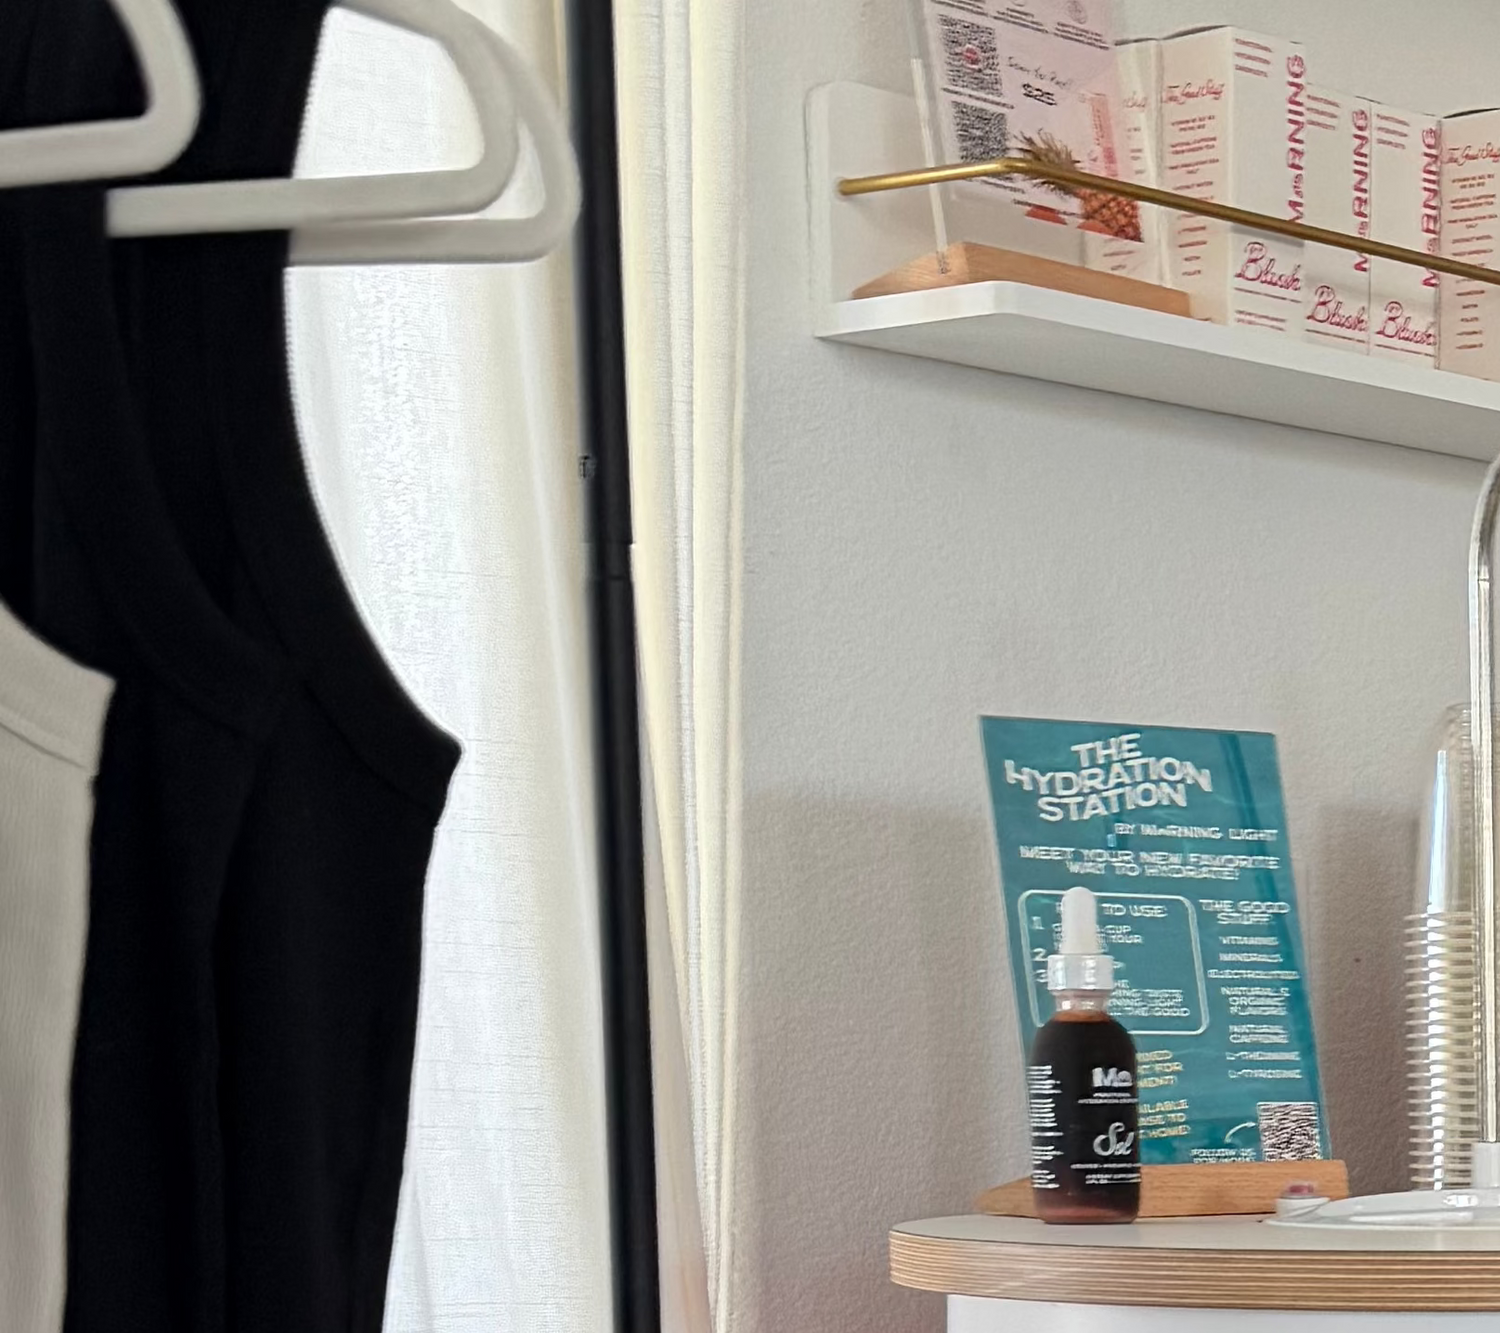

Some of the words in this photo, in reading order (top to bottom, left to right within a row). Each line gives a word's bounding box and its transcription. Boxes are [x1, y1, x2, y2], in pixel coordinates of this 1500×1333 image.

[1022, 82, 1057, 106] $25
[1234, 241, 1301, 291] Blush
[1306, 285, 1368, 332] Blush
[1375, 300, 1438, 346] Blush
[1070, 732, 1142, 768] THE
[1004, 756, 1213, 795] HYDRATION
[1036, 782, 1188, 822] STATION
[1114, 823, 1134, 835] BY
[1228, 828, 1279, 841] LIGHT
[1020, 845, 1075, 860] MEET
[1083, 848, 1135, 863] YOUR
[1139, 851, 1183, 865] NEW
[1188, 853, 1281, 869] FAVORITE
[1066, 861, 1106, 875] WAY
[1115, 862, 1140, 876] TO
[1100, 903, 1126, 916] TO
[1199, 899, 1235, 913] THE
[1237, 900, 1290, 914] GOOD
